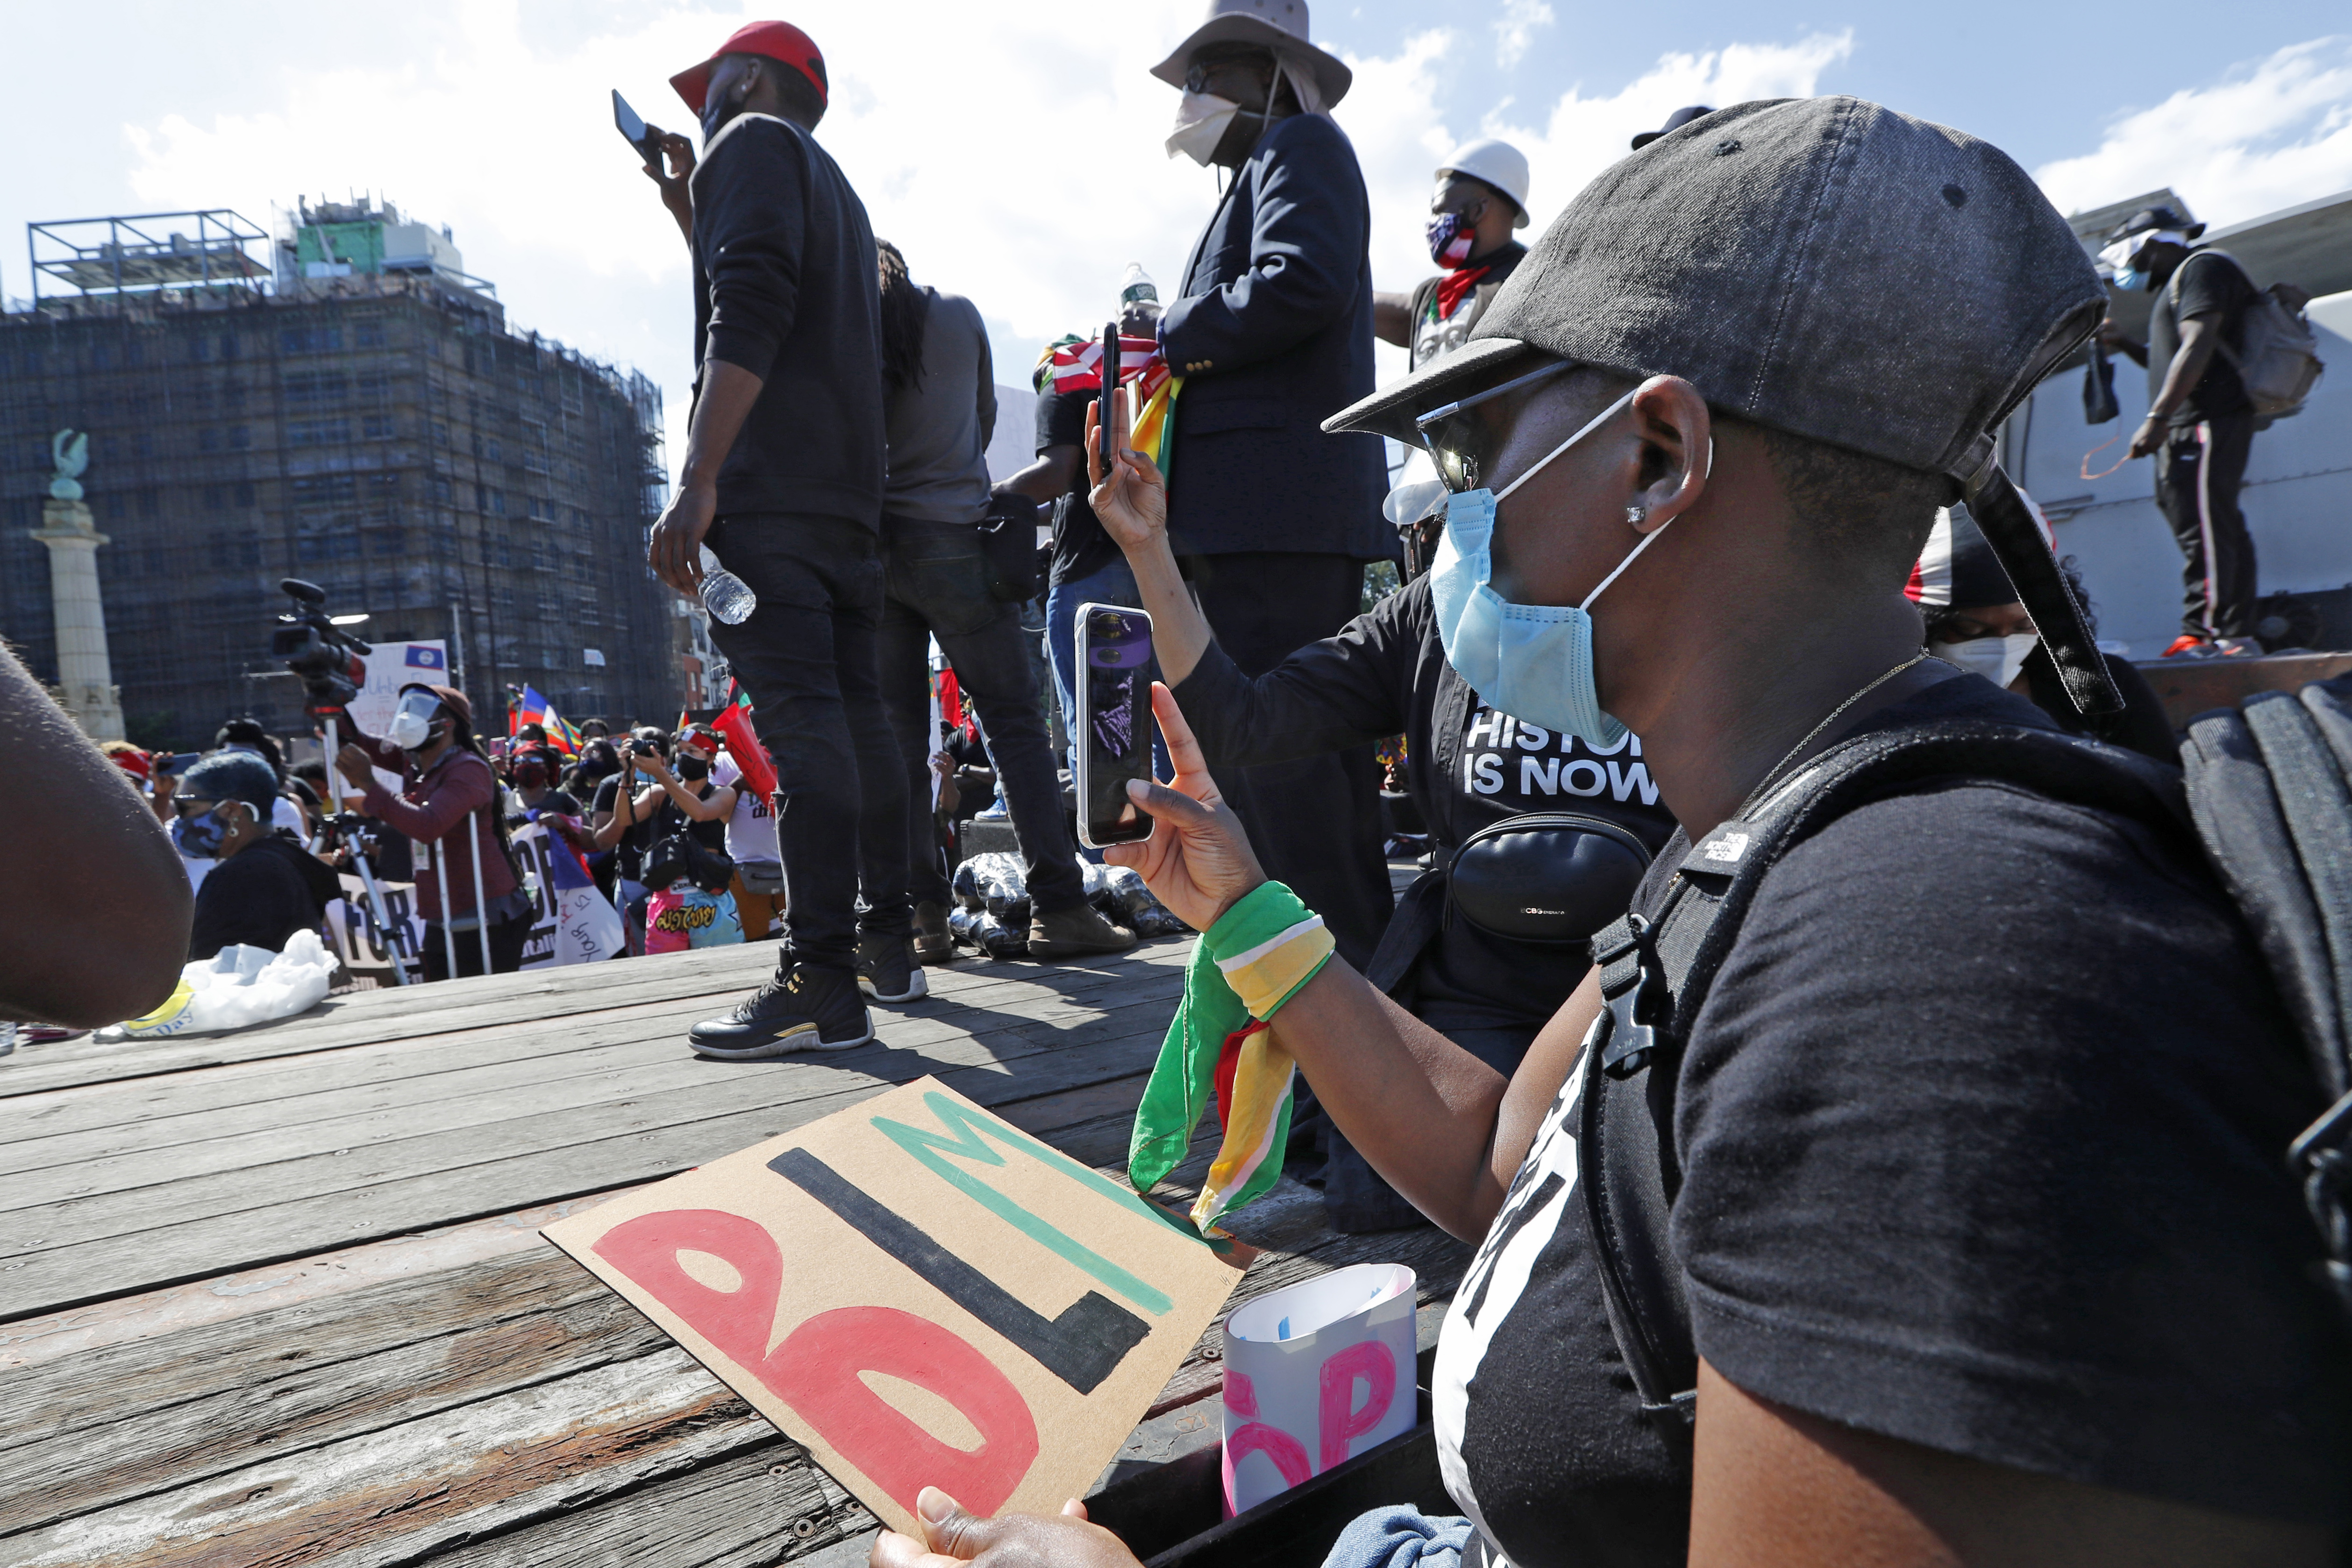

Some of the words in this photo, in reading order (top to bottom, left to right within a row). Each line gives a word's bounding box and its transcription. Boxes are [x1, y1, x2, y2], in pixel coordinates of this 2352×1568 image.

[1464, 752, 1504, 794] IS
[1521, 755, 1659, 805] NOW
[591, 1091, 1234, 1522] BLM
